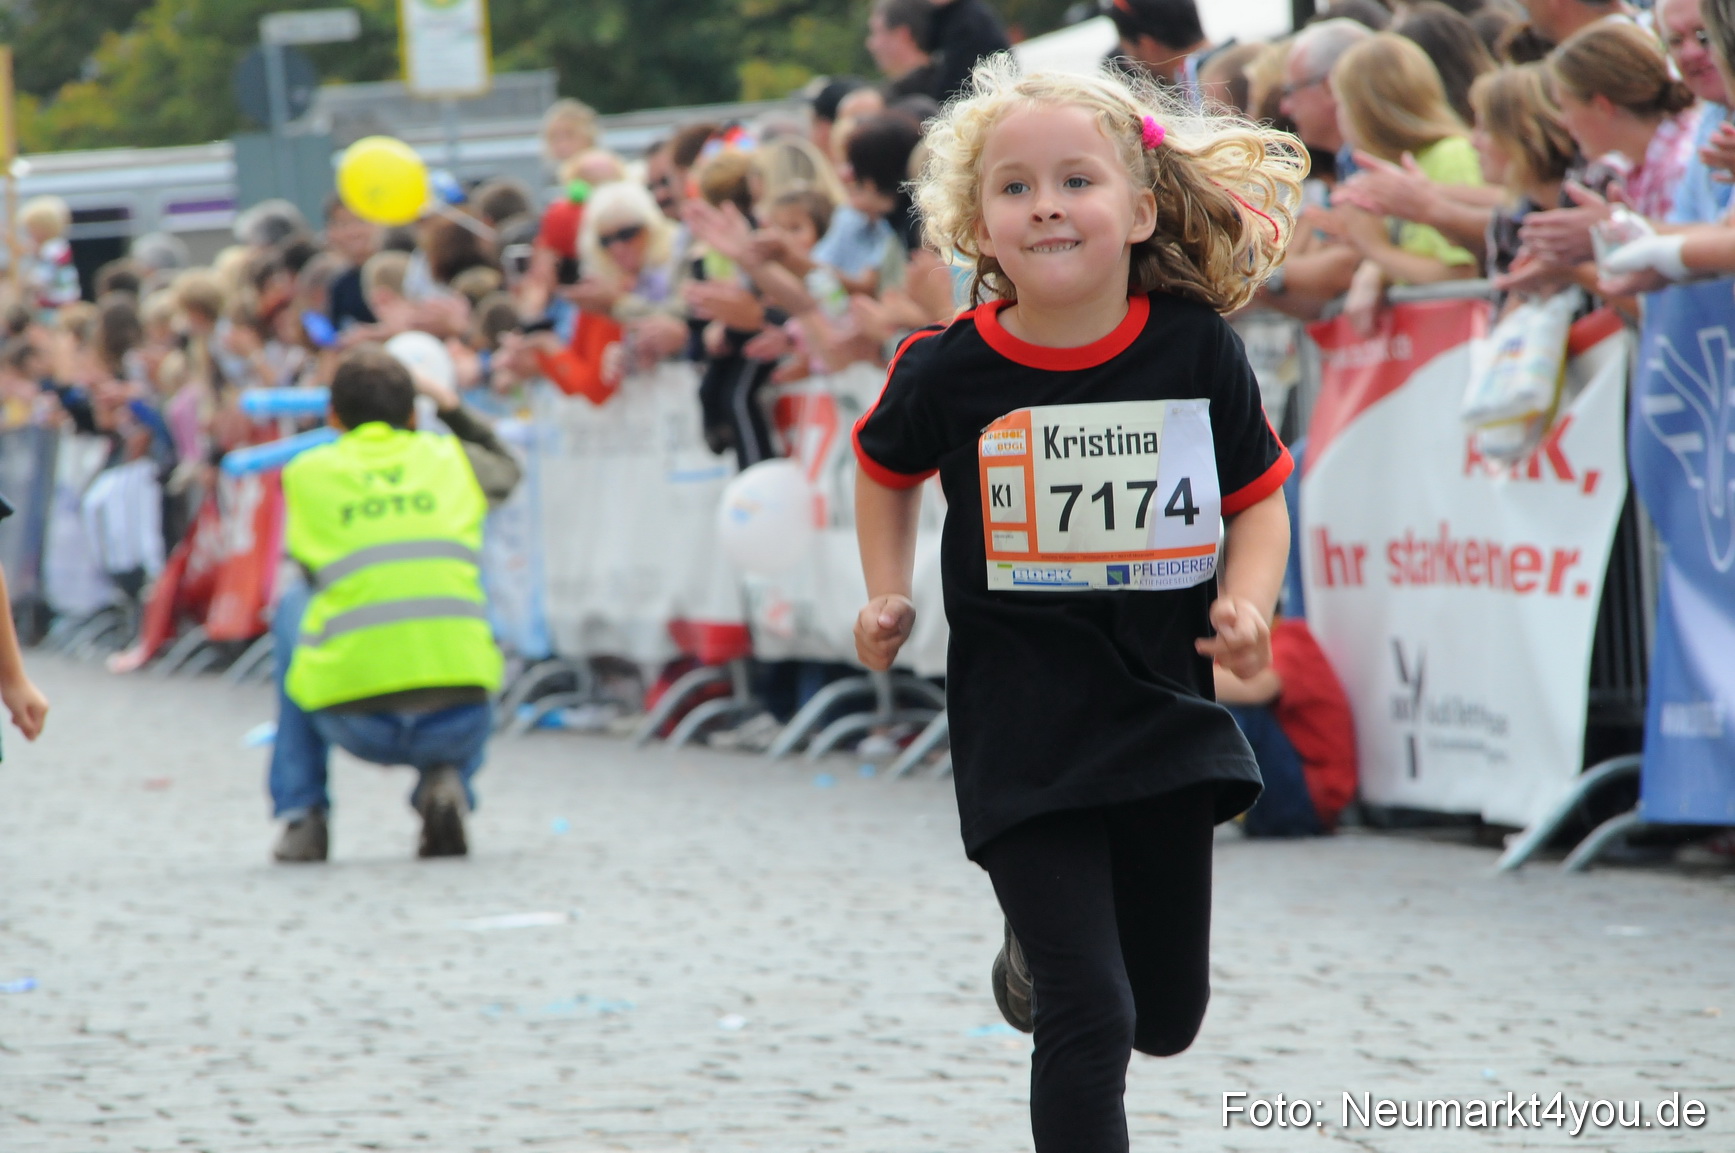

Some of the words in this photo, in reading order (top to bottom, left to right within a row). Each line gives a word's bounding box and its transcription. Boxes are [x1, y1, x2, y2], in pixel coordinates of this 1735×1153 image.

[1043, 425, 1158, 459] Kristina
[991, 484, 1012, 508] K1
[1050, 477, 1200, 532] 7174
[1133, 557, 1215, 576] PFLEIDERER
